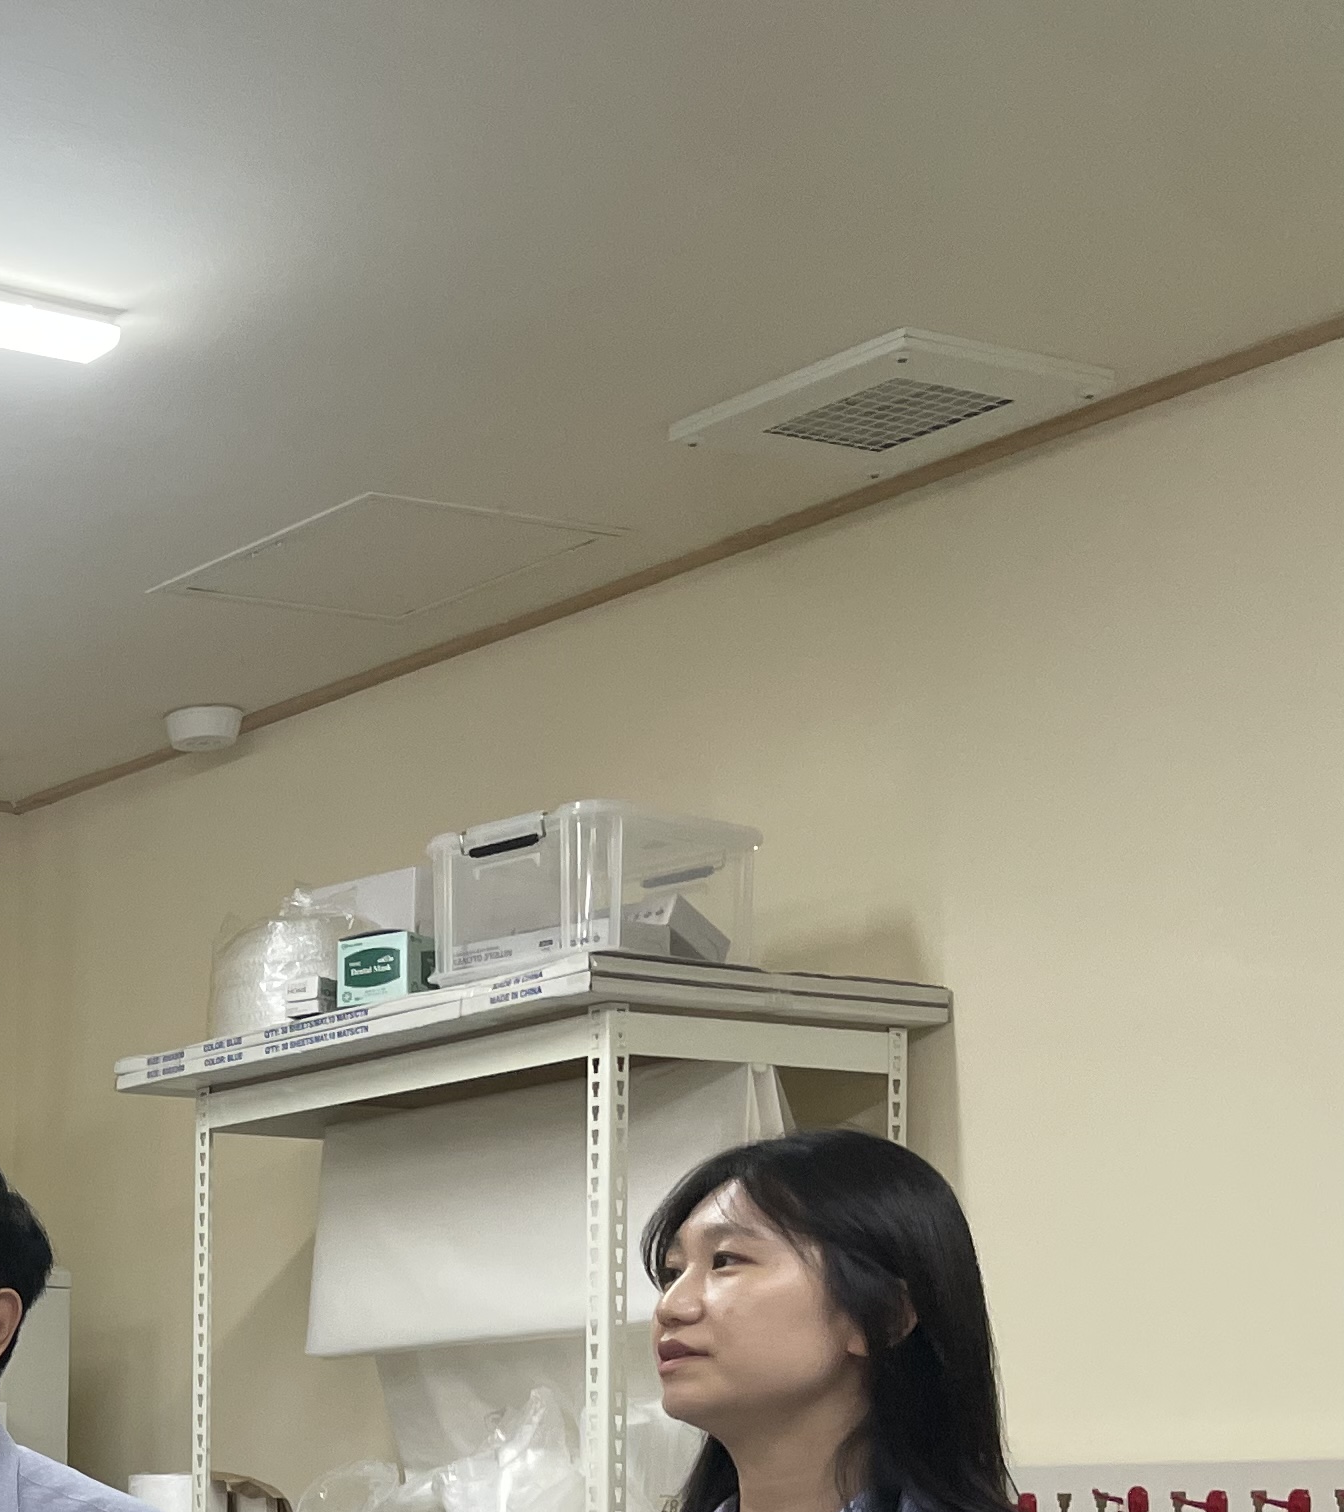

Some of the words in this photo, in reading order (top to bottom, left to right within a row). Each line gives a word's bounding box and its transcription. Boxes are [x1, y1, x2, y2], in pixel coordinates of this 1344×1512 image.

[350, 966, 372, 977] Dental
[373, 963, 392, 973] Mask
[490, 992, 510, 1004] MADE
[520, 985, 542, 998] CHINA
[226, 1036, 243, 1048] BLUE
[227, 1051, 243, 1063] BLUE
